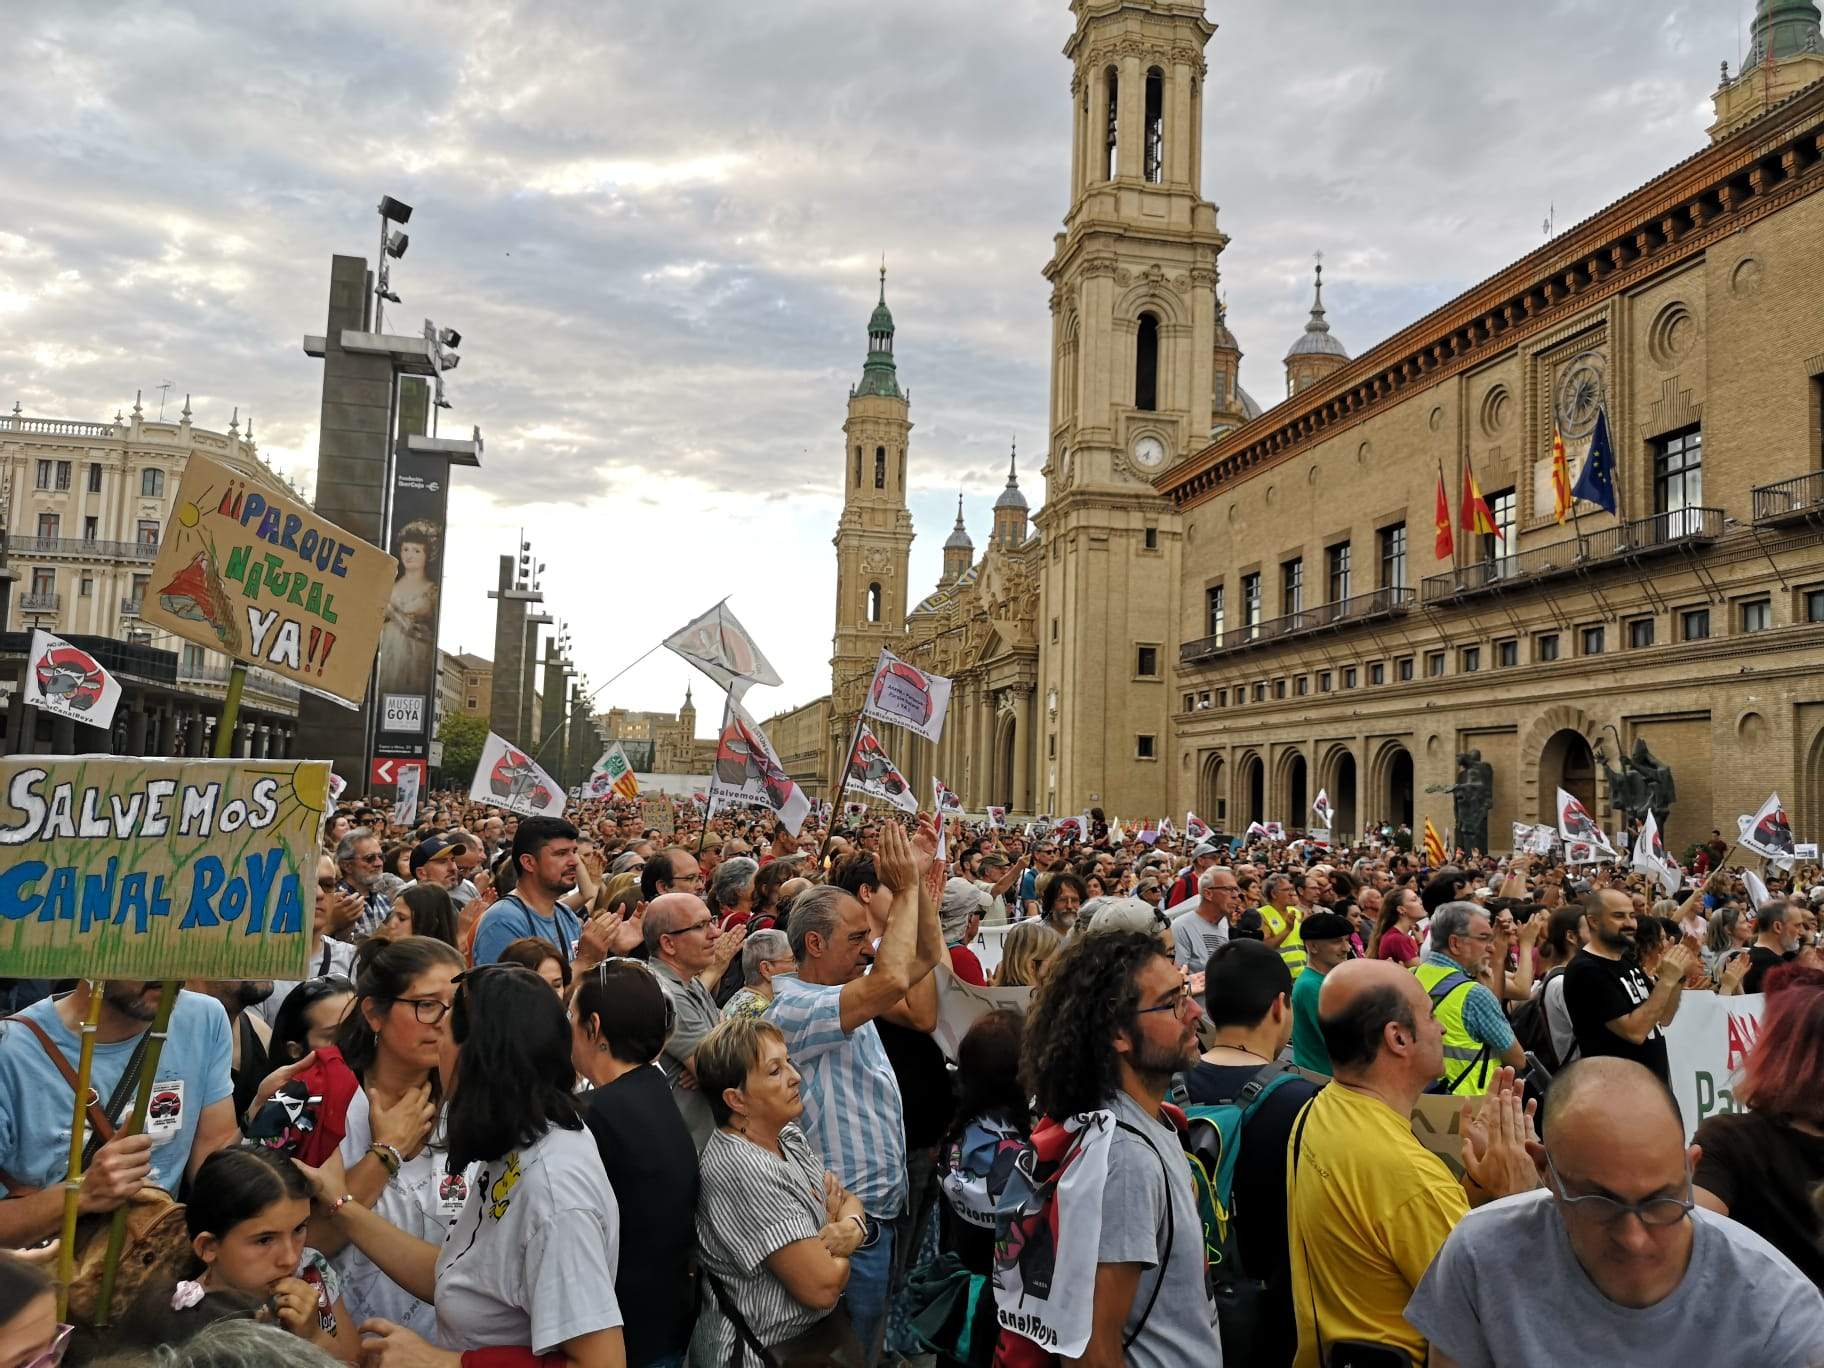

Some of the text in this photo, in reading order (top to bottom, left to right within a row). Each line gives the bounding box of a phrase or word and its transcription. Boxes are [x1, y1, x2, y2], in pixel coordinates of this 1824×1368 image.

[217, 479, 356, 579] ¡¡PARQUE
[224, 545, 338, 624] NATURAL
[246, 605, 337, 678] YA!!
[387, 709, 419, 721] GOYA
[0, 767, 279, 847] SALVEMOS
[0, 847, 303, 936] CANAL ROYA
